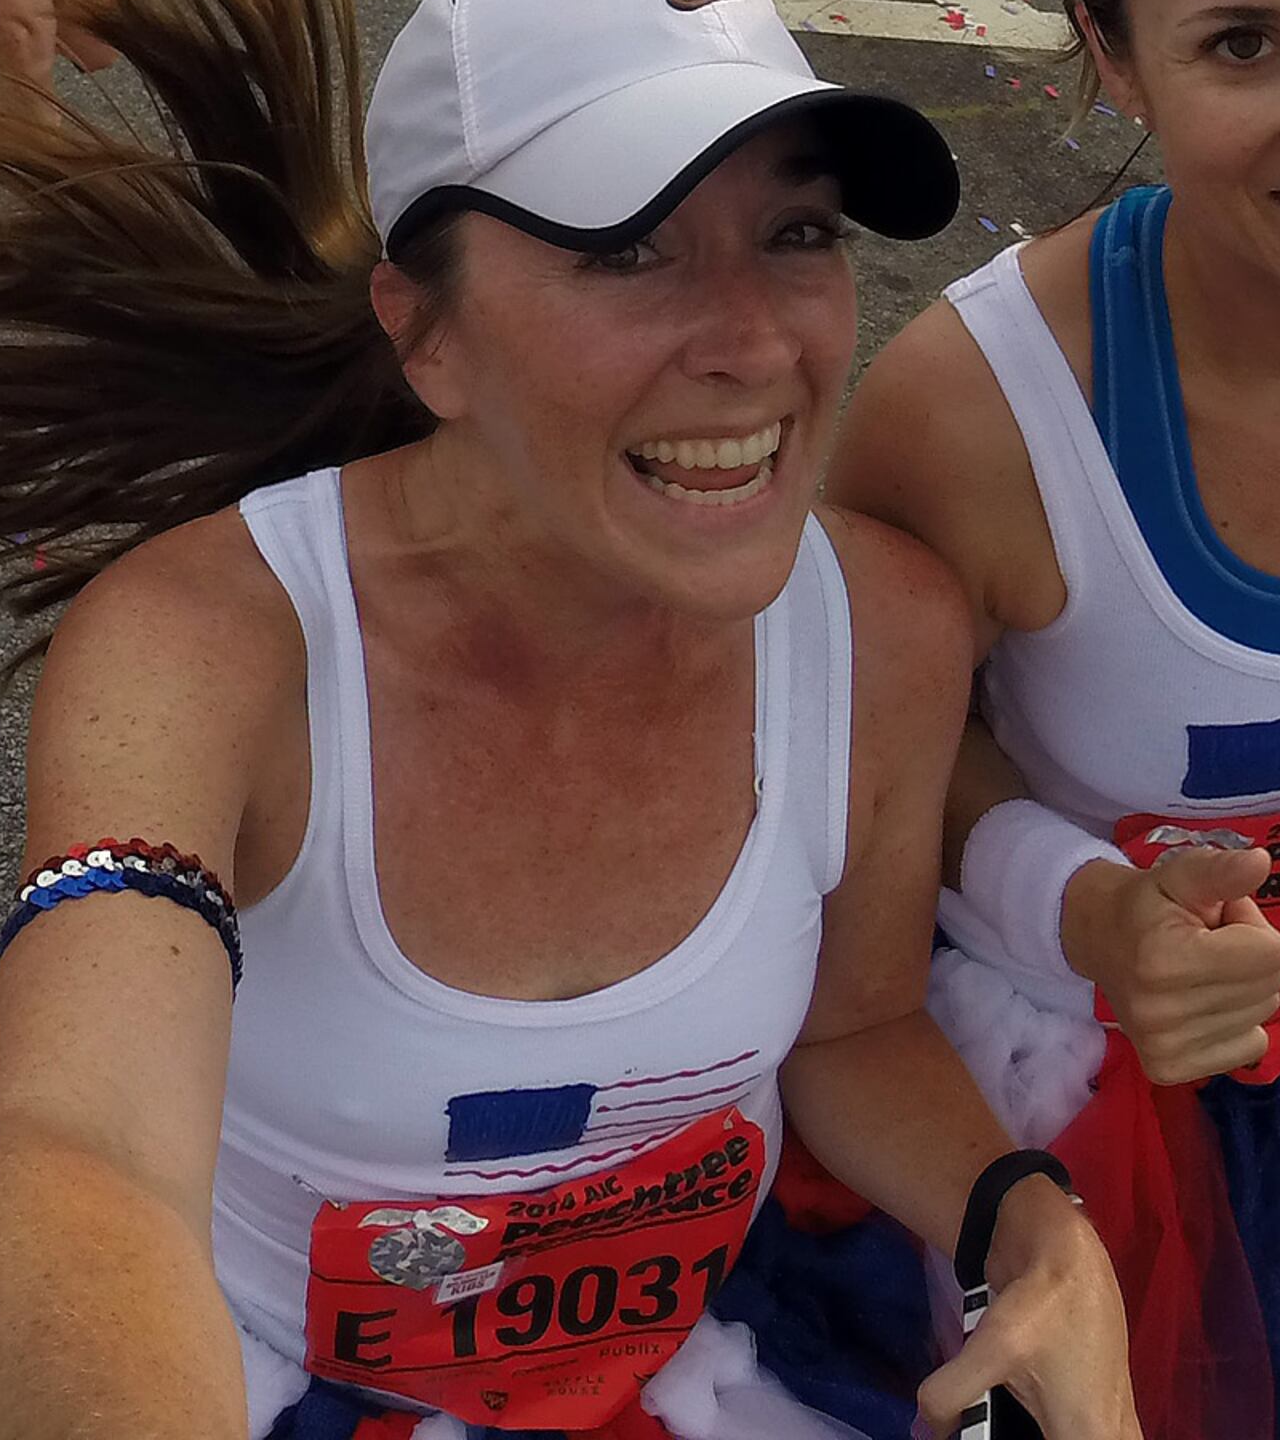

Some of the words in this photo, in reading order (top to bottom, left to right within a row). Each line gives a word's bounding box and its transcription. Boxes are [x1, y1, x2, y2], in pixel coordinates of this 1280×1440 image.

[507, 1191, 577, 1217] 2014
[583, 1176, 623, 1205] AJC
[334, 1308, 398, 1367] E
[440, 1248, 728, 1358] 19031
